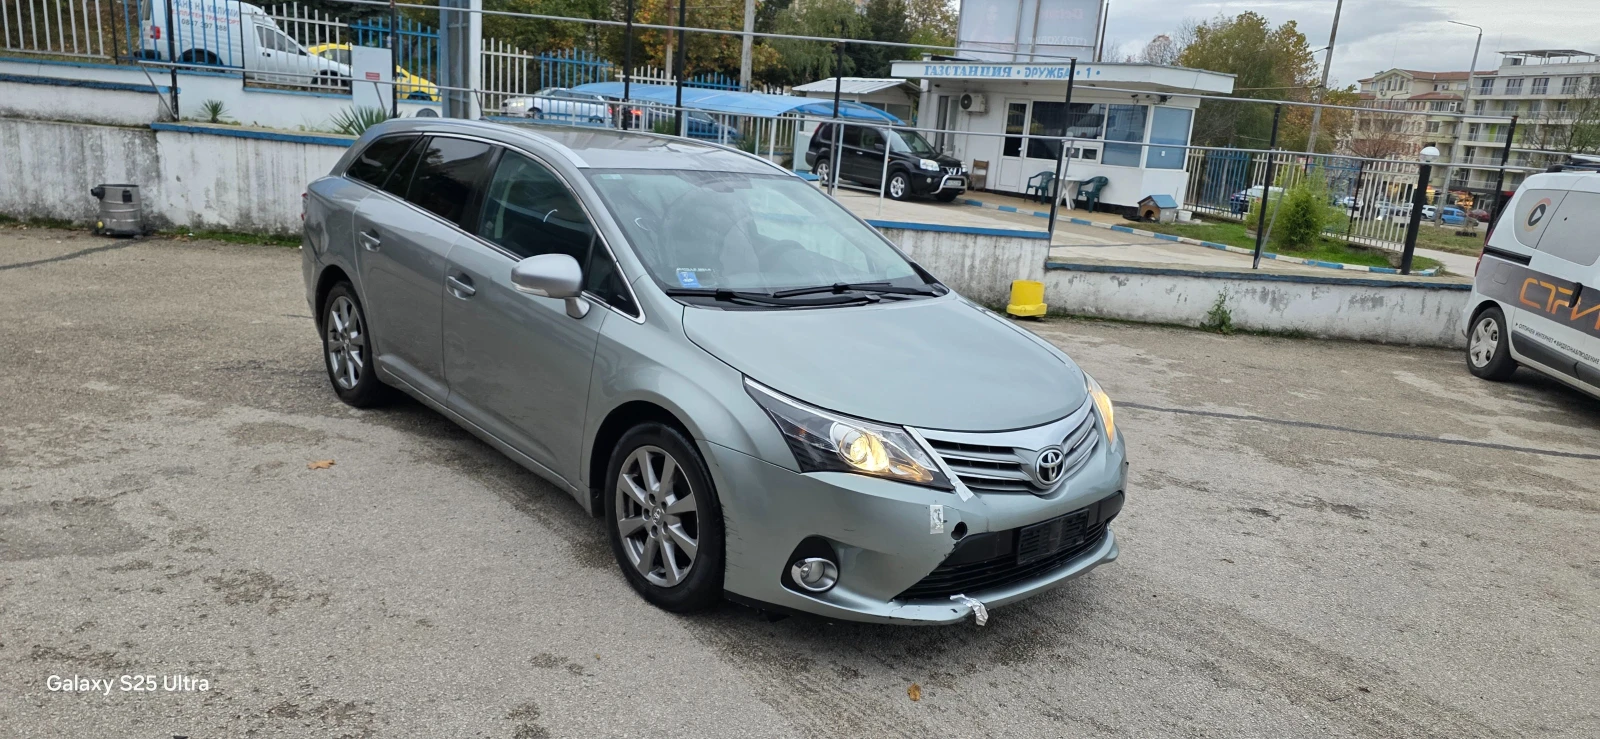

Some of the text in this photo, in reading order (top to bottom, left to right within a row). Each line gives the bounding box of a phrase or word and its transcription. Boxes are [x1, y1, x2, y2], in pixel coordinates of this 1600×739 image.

[207, 5, 239, 17] КЛИМИ
[181, 18, 198, 26] 087
[924, 65, 1092, 79] ГАЗСТАНЦИЯ ДРУЖБА 1
[1535, 330, 1554, 343] ИНТЕРНЕТ
